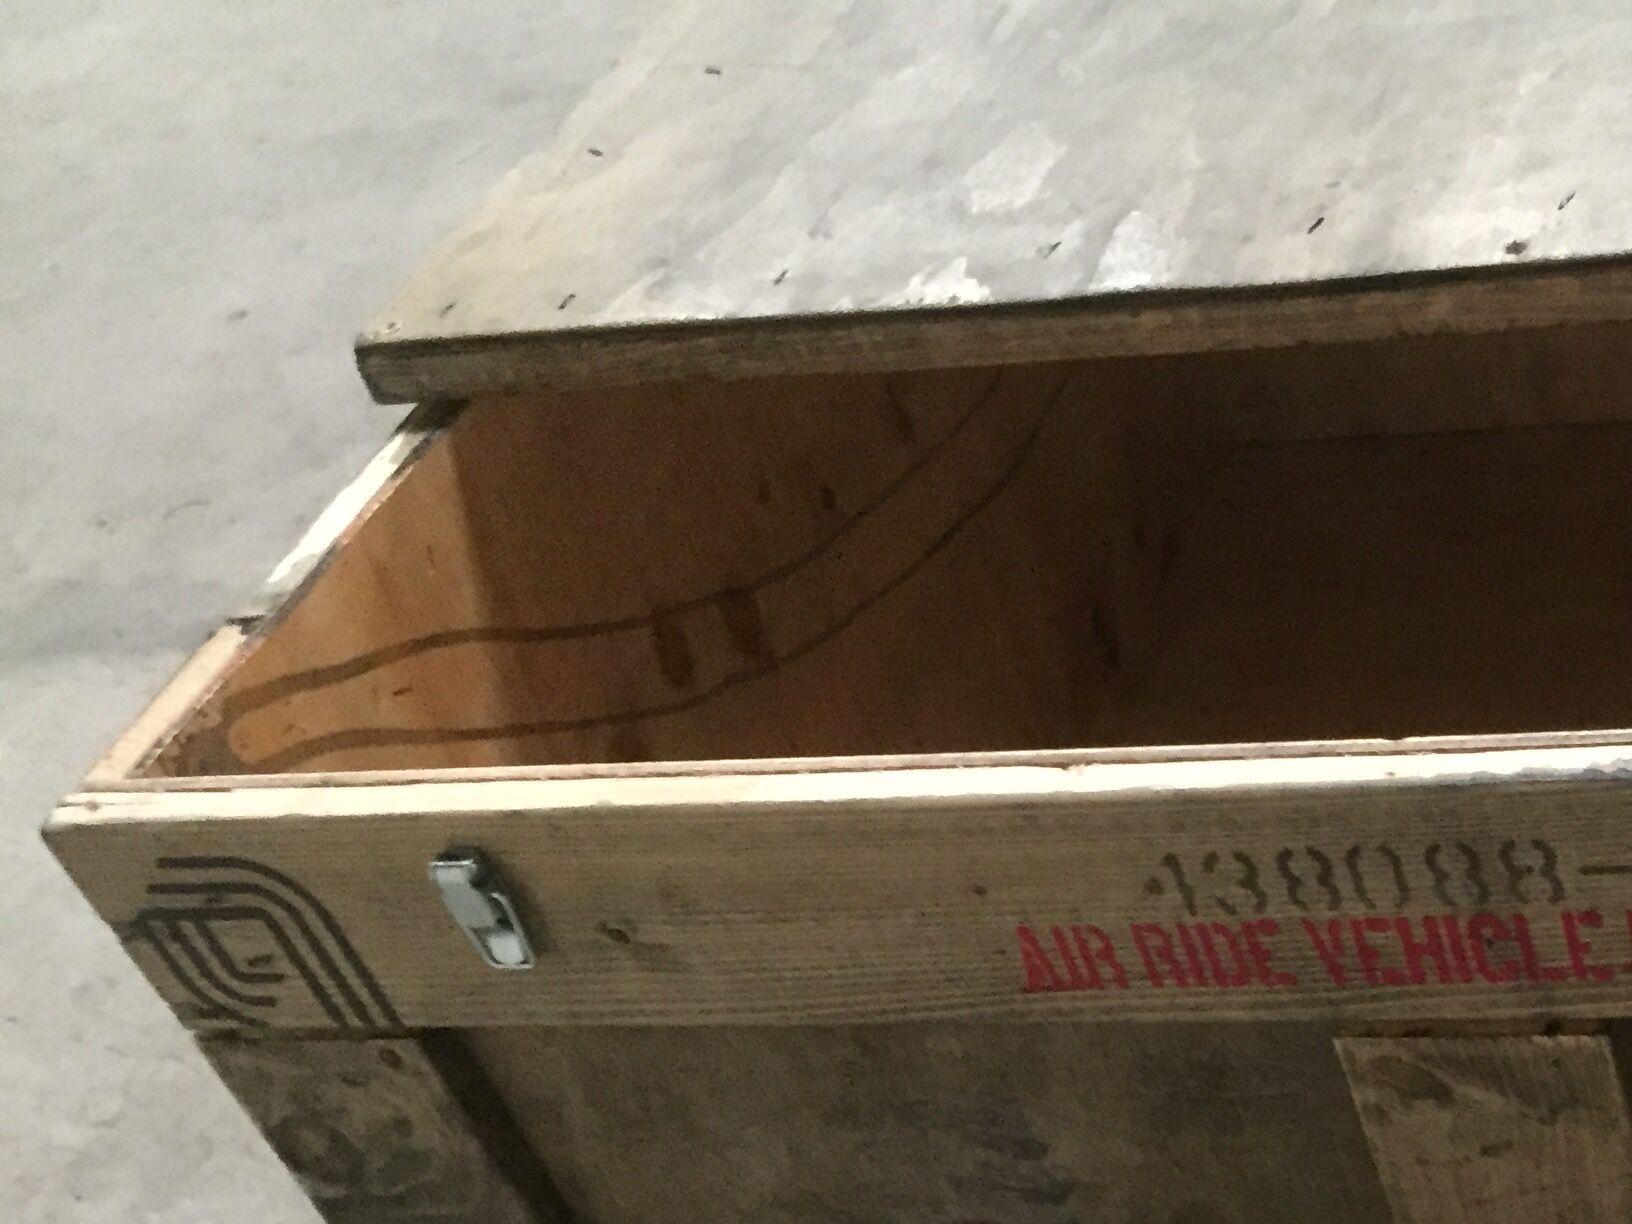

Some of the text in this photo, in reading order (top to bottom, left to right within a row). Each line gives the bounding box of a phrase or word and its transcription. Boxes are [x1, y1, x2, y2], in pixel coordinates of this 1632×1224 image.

[1014, 921, 1130, 993] AIR
[1131, 917, 1299, 989] RIDE
[1301, 910, 1615, 987] VEHICLE
